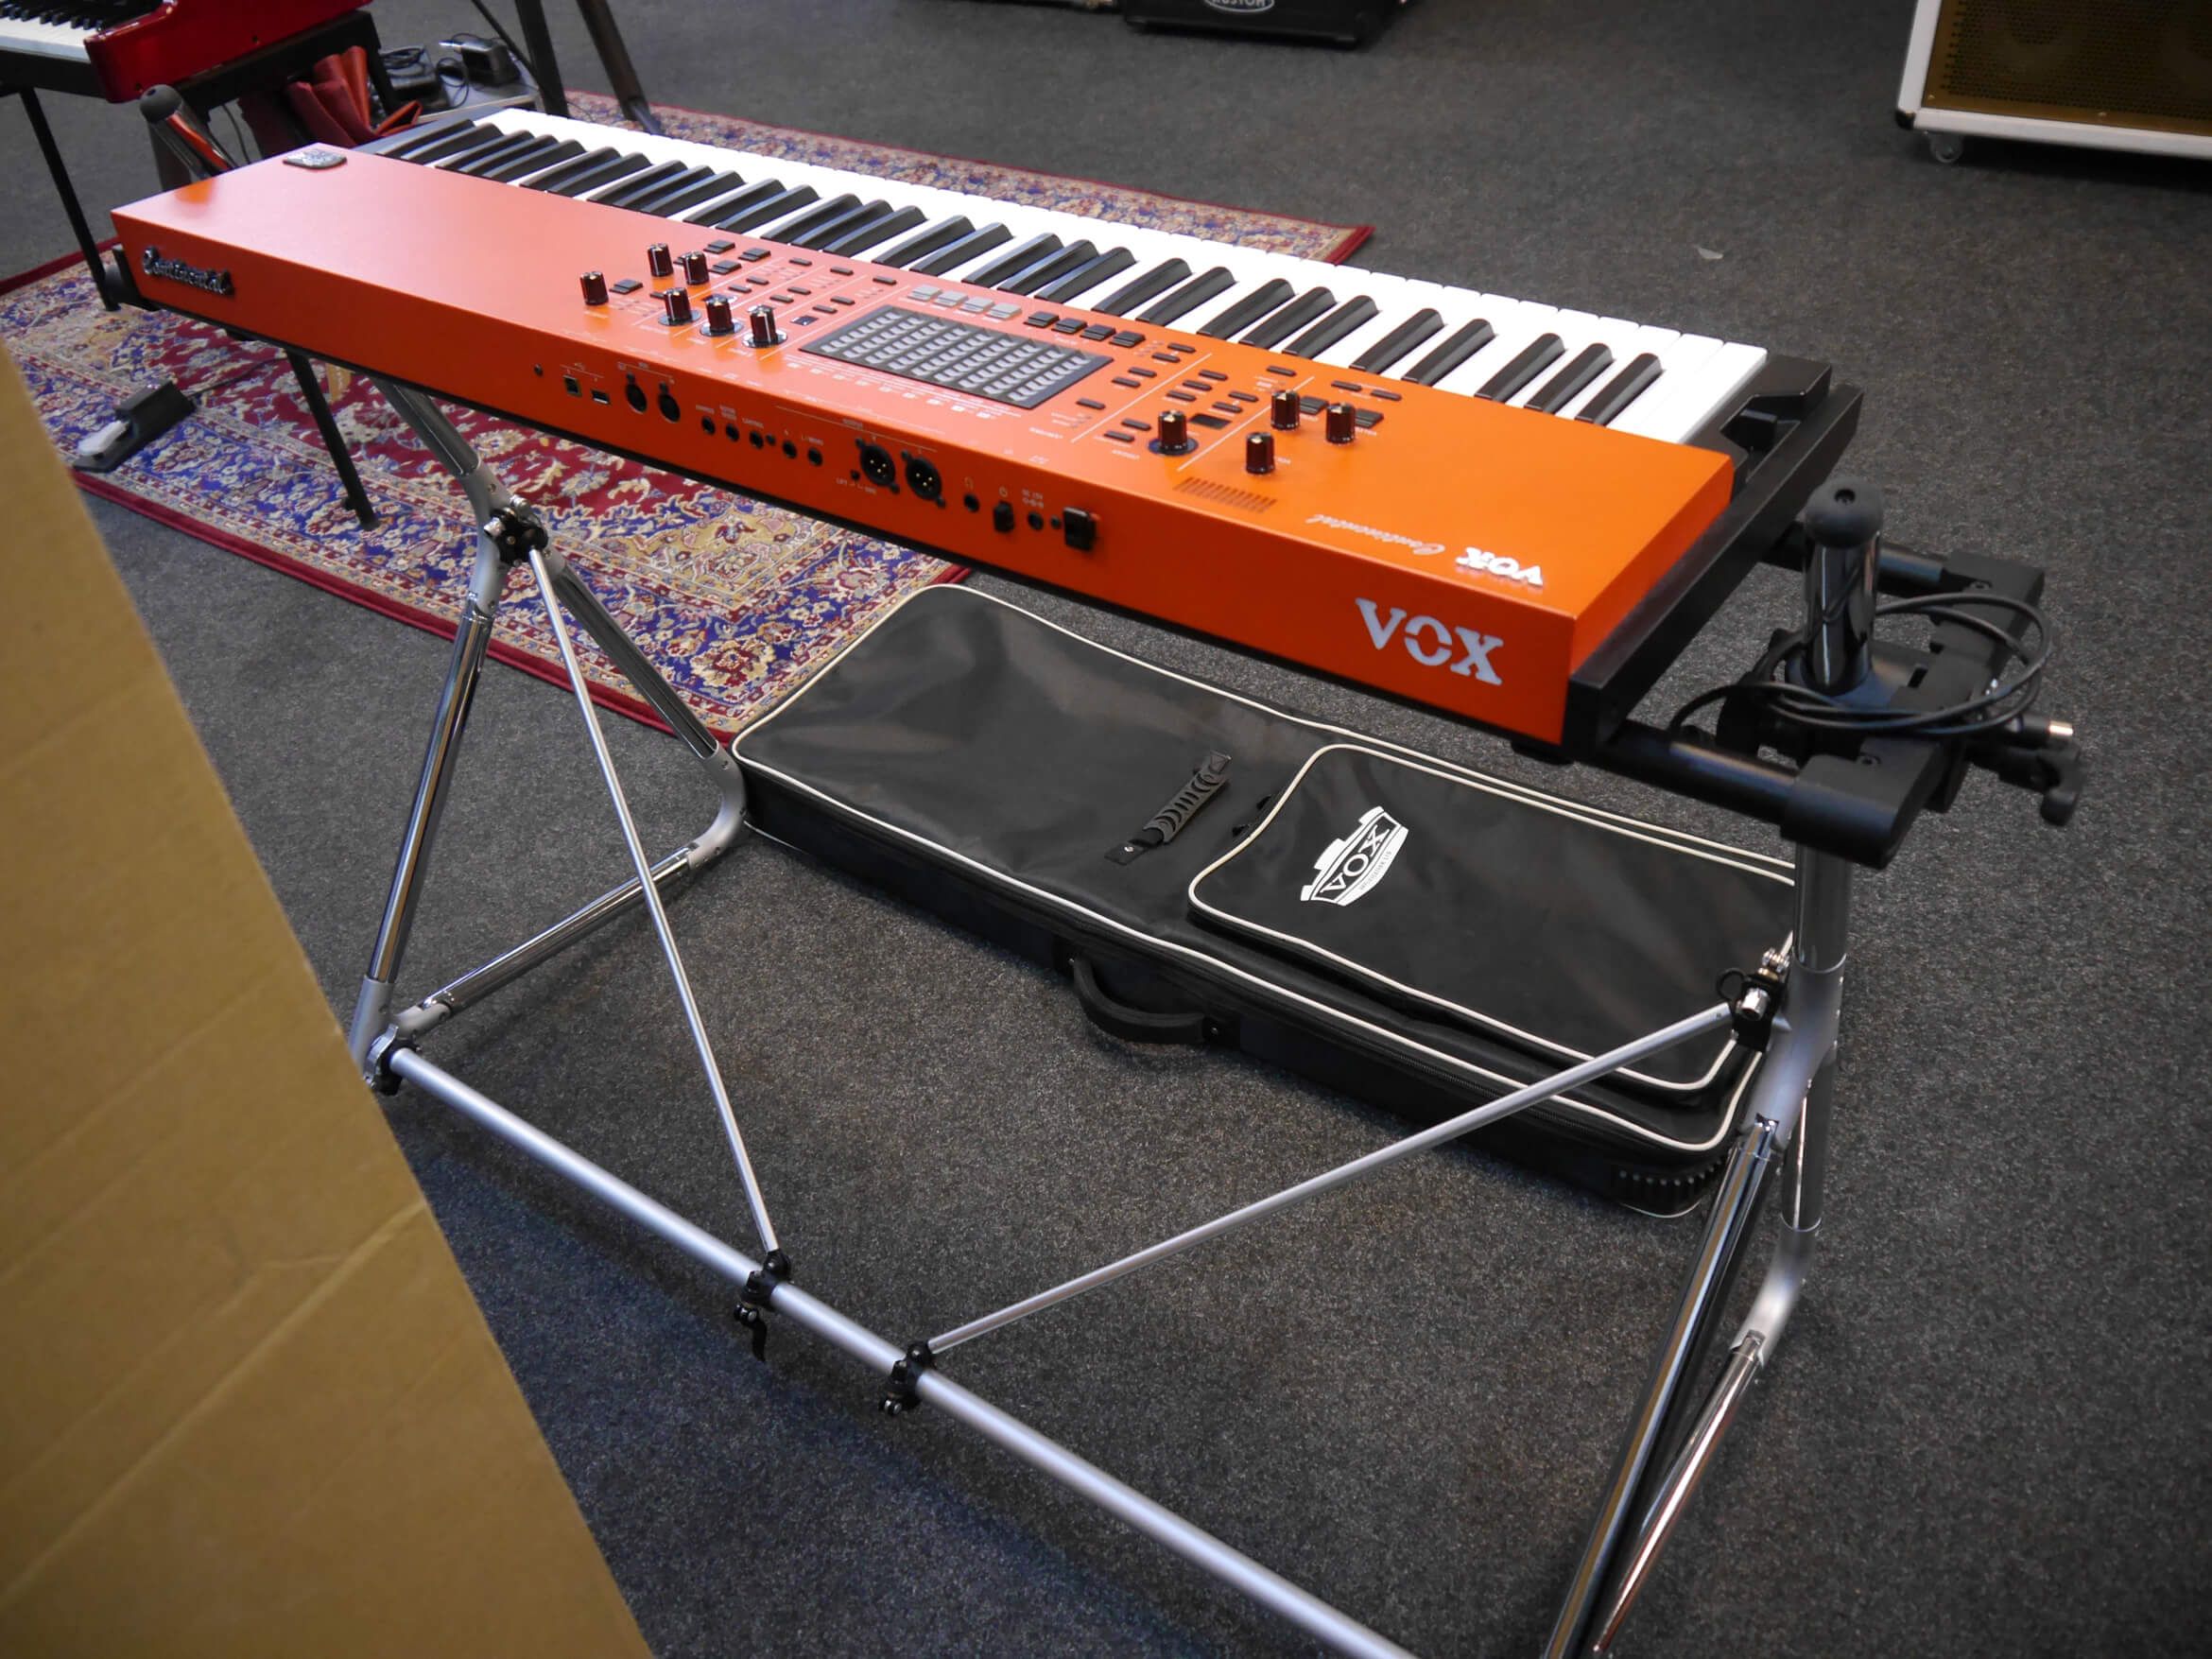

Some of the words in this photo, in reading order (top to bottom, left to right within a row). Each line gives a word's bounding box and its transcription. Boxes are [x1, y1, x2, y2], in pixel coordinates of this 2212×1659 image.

[1456, 546, 1544, 583] VOX
[1355, 597, 1504, 685] VOX
[1321, 824, 1390, 884] VOX
